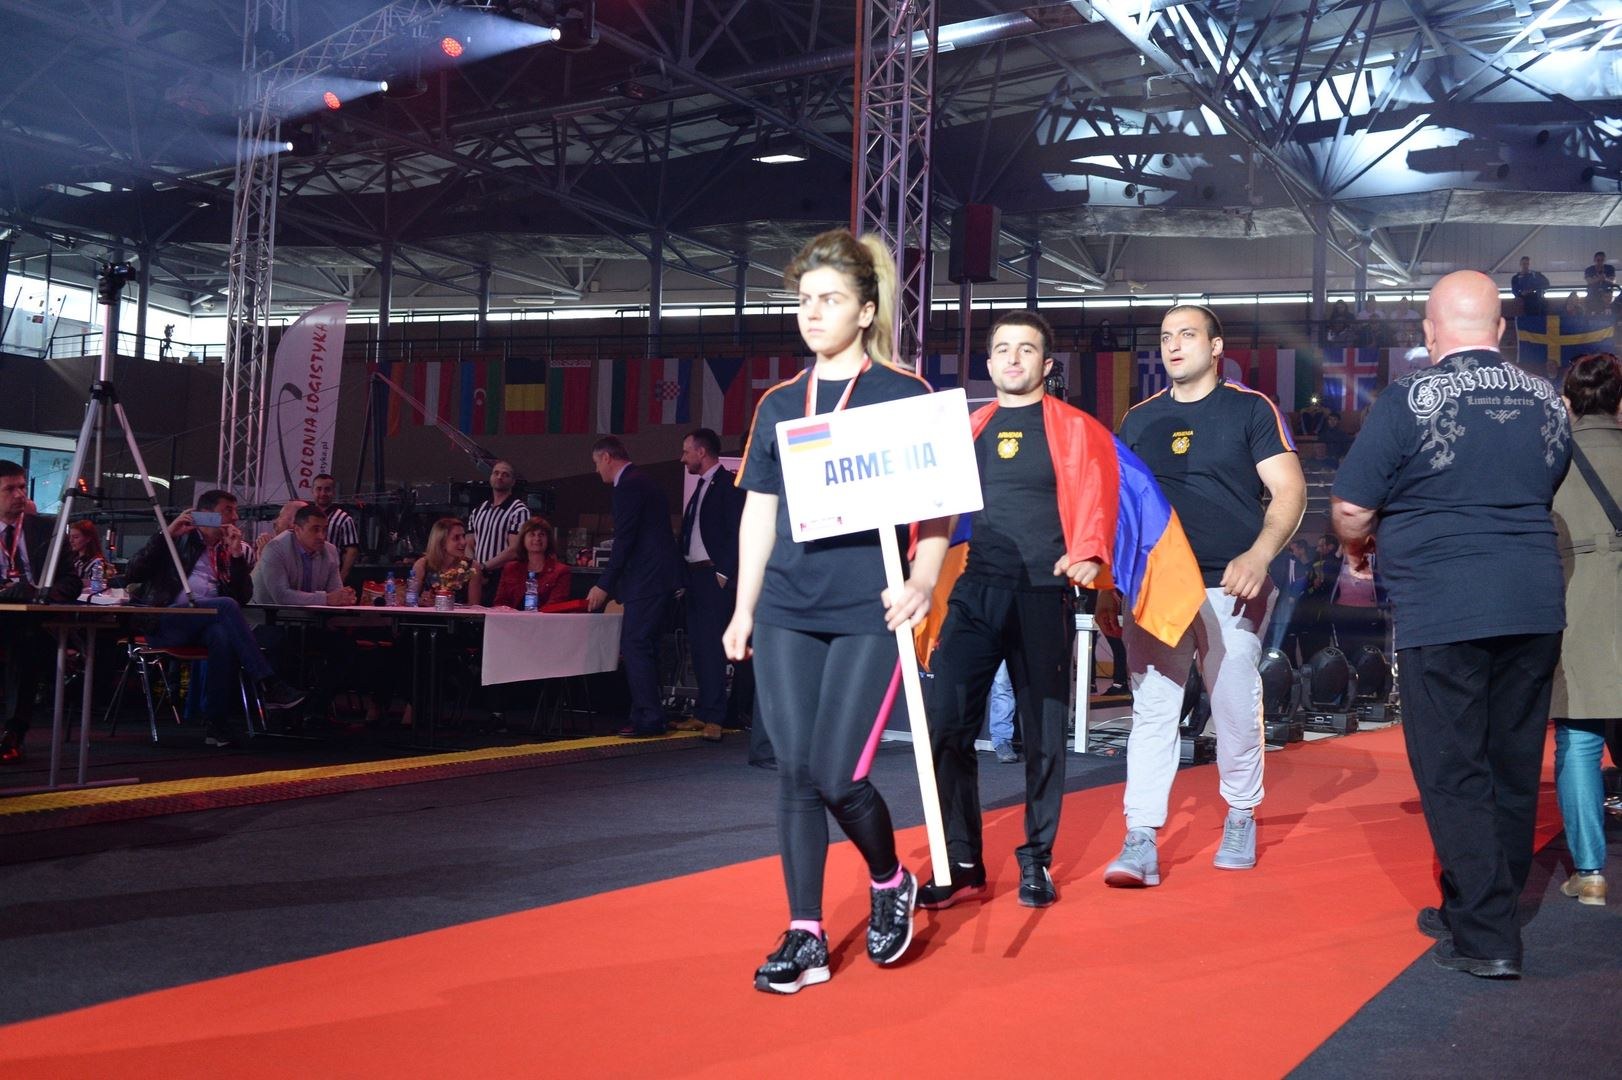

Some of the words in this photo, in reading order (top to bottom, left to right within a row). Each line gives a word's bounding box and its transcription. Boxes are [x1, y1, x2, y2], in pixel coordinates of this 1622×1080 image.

[306, 323, 328, 416] LOGISTYKA
[1465, 395, 1501, 405] Limited
[1503, 395, 1535, 406] Series
[299, 418, 317, 488] POLONIA
